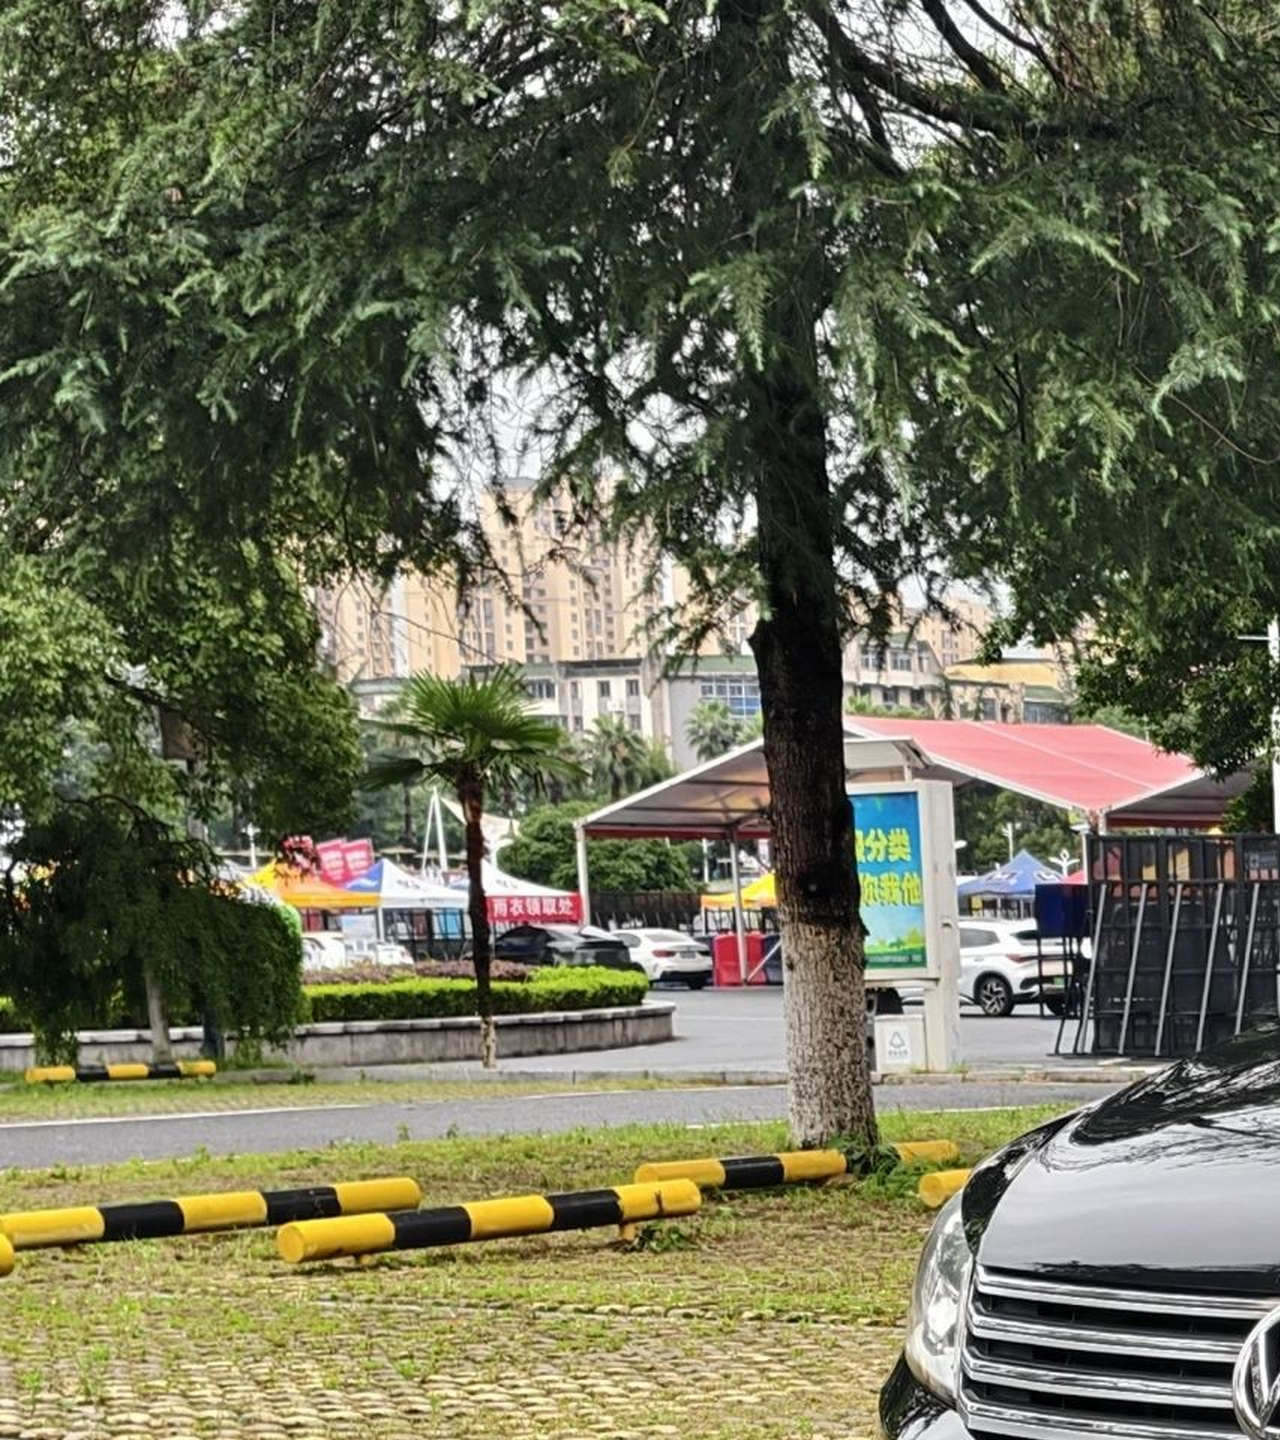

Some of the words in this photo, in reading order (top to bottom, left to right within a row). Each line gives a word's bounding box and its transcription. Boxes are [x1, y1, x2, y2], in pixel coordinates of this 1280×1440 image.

[492, 896, 574, 917] 雨衣领取处
